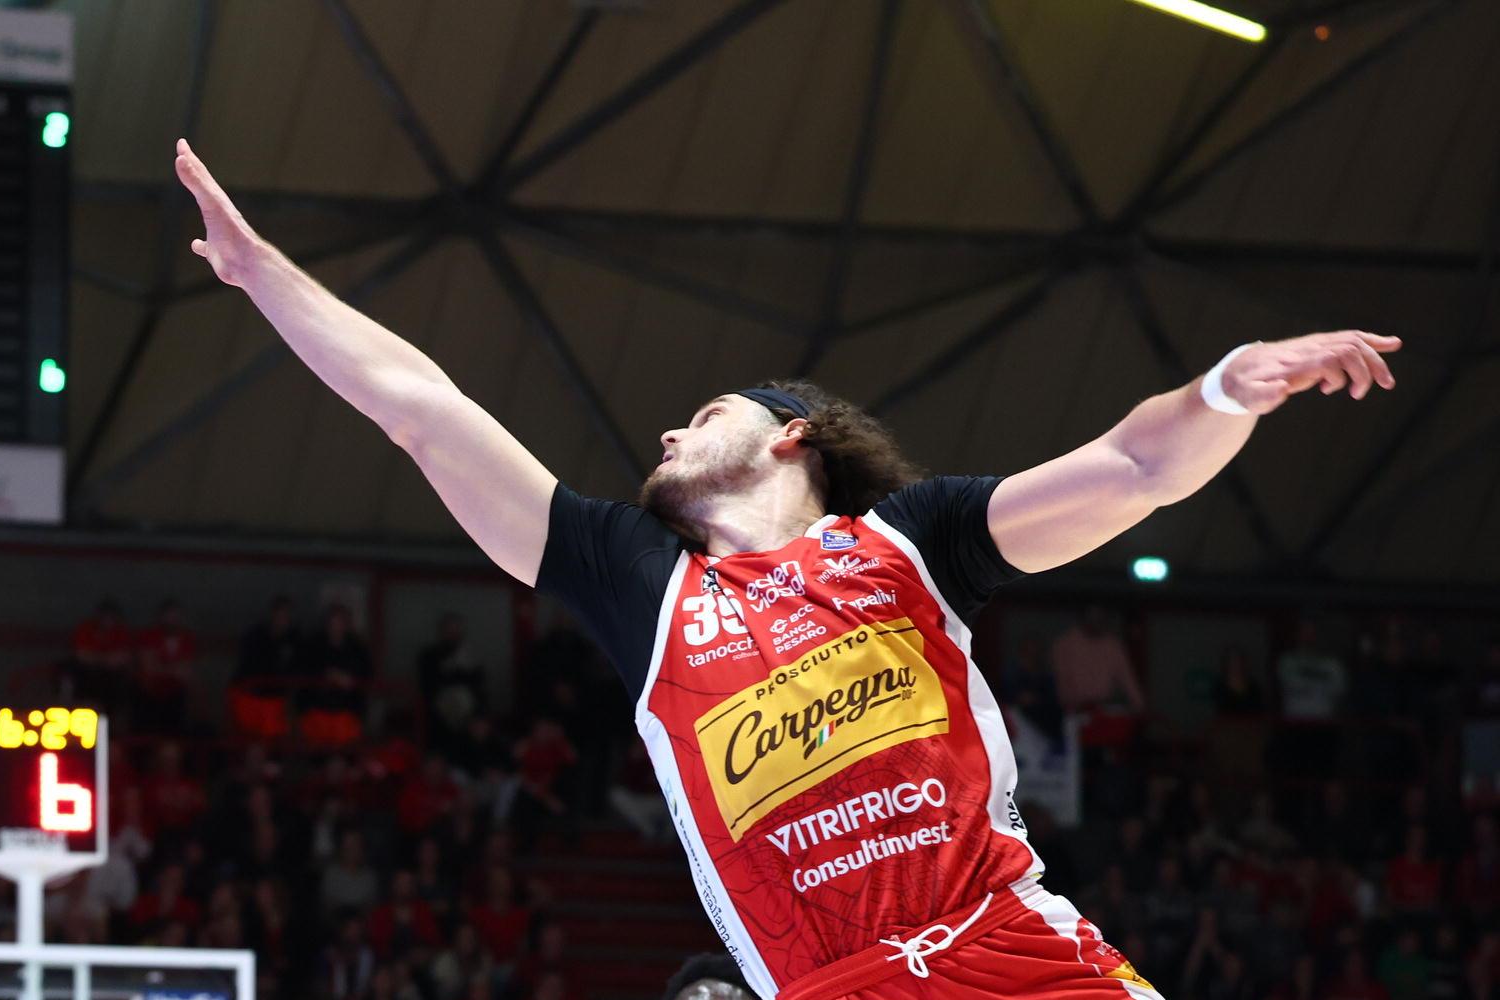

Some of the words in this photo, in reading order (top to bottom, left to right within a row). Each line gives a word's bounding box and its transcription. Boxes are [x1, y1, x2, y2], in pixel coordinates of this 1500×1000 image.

[746, 560, 802, 600] eden
[772, 620, 816, 646] BANCA
[776, 625, 827, 655] PESARO
[789, 604, 815, 623] BCC
[725, 666, 917, 785] Carpegna
[39, 752, 92, 831] 6
[765, 778, 947, 857] VITRIFRIGO
[792, 821, 952, 893] Consultinvest
